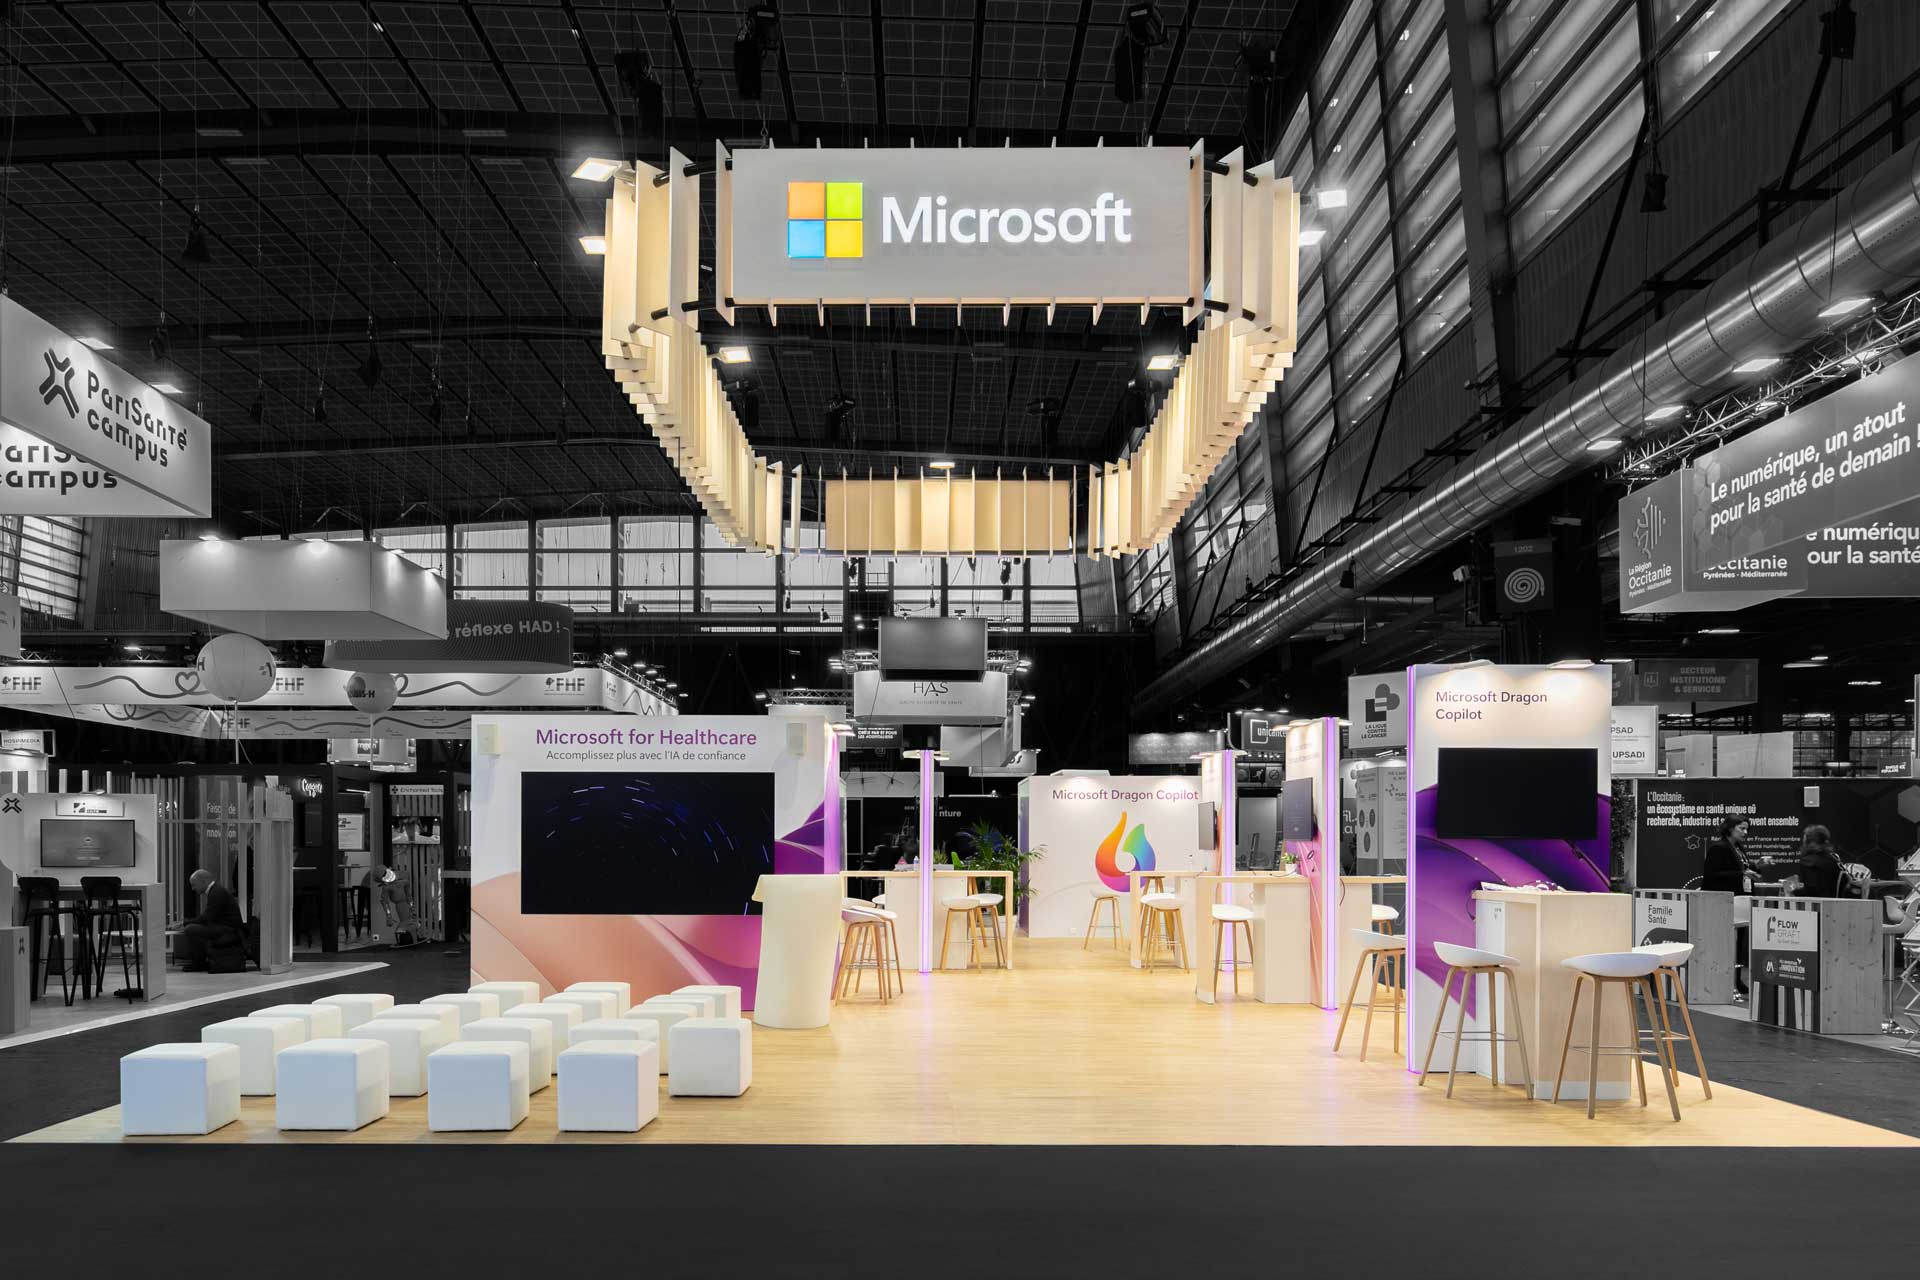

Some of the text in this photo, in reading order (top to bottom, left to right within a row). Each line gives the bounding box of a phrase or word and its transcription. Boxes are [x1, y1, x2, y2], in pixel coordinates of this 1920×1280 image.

[881, 192, 1132, 244] Microsoft
[87, 369, 187, 451] PariSanté
[87, 408, 168, 467] campus
[0, 445, 86, 463] ariS
[1711, 401, 1906, 503] Le numérique, un atout
[0, 471, 118, 495] ampus
[1711, 501, 1744, 535] pour
[1748, 492, 1760, 514] la
[1764, 470, 1808, 508] santé
[1811, 462, 1835, 489] de
[1839, 433, 1910, 478] demain
[1848, 545, 1864, 564] la
[1869, 547, 1920, 564] santé
[1628, 561, 1652, 576] La Région
[1703, 572, 1736, 580] Pyrénées
[1740, 570, 1788, 578] Méditerranée
[1628, 564, 1672, 590] Occitanie
[455, 622, 514, 638] réflexe
[519, 620, 552, 632] HAD
[12, 677, 42, 690] FHF
[276, 678, 304, 691] FHF
[556, 678, 585, 692] FHF
[914, 681, 948, 696] HAS
[1436, 691, 1548, 706] Microsoft Dragon
[1436, 708, 1482, 722] Copilot
[536, 728, 757, 745] Microsoft for Healthcare
[546, 750, 614, 763] Accomplissez
[616, 750, 637, 763] plus
[639, 752, 662, 760] avec
[682, 750, 696, 760] de
[698, 750, 746, 760] confiance
[1052, 789, 1198, 804] Microsoft Dragon Copilot
[1647, 804, 1756, 816] un écosystème en santé unique où
[1647, 816, 1682, 827] recherche,
[1682, 816, 1712, 826] industrie
[1712, 817, 1720, 826] et
[1768, 816, 1799, 826] ensemble
[1648, 904, 1672, 916] Famille
[1648, 914, 1667, 924] Santé
[1778, 920, 1798, 929] FLOW
